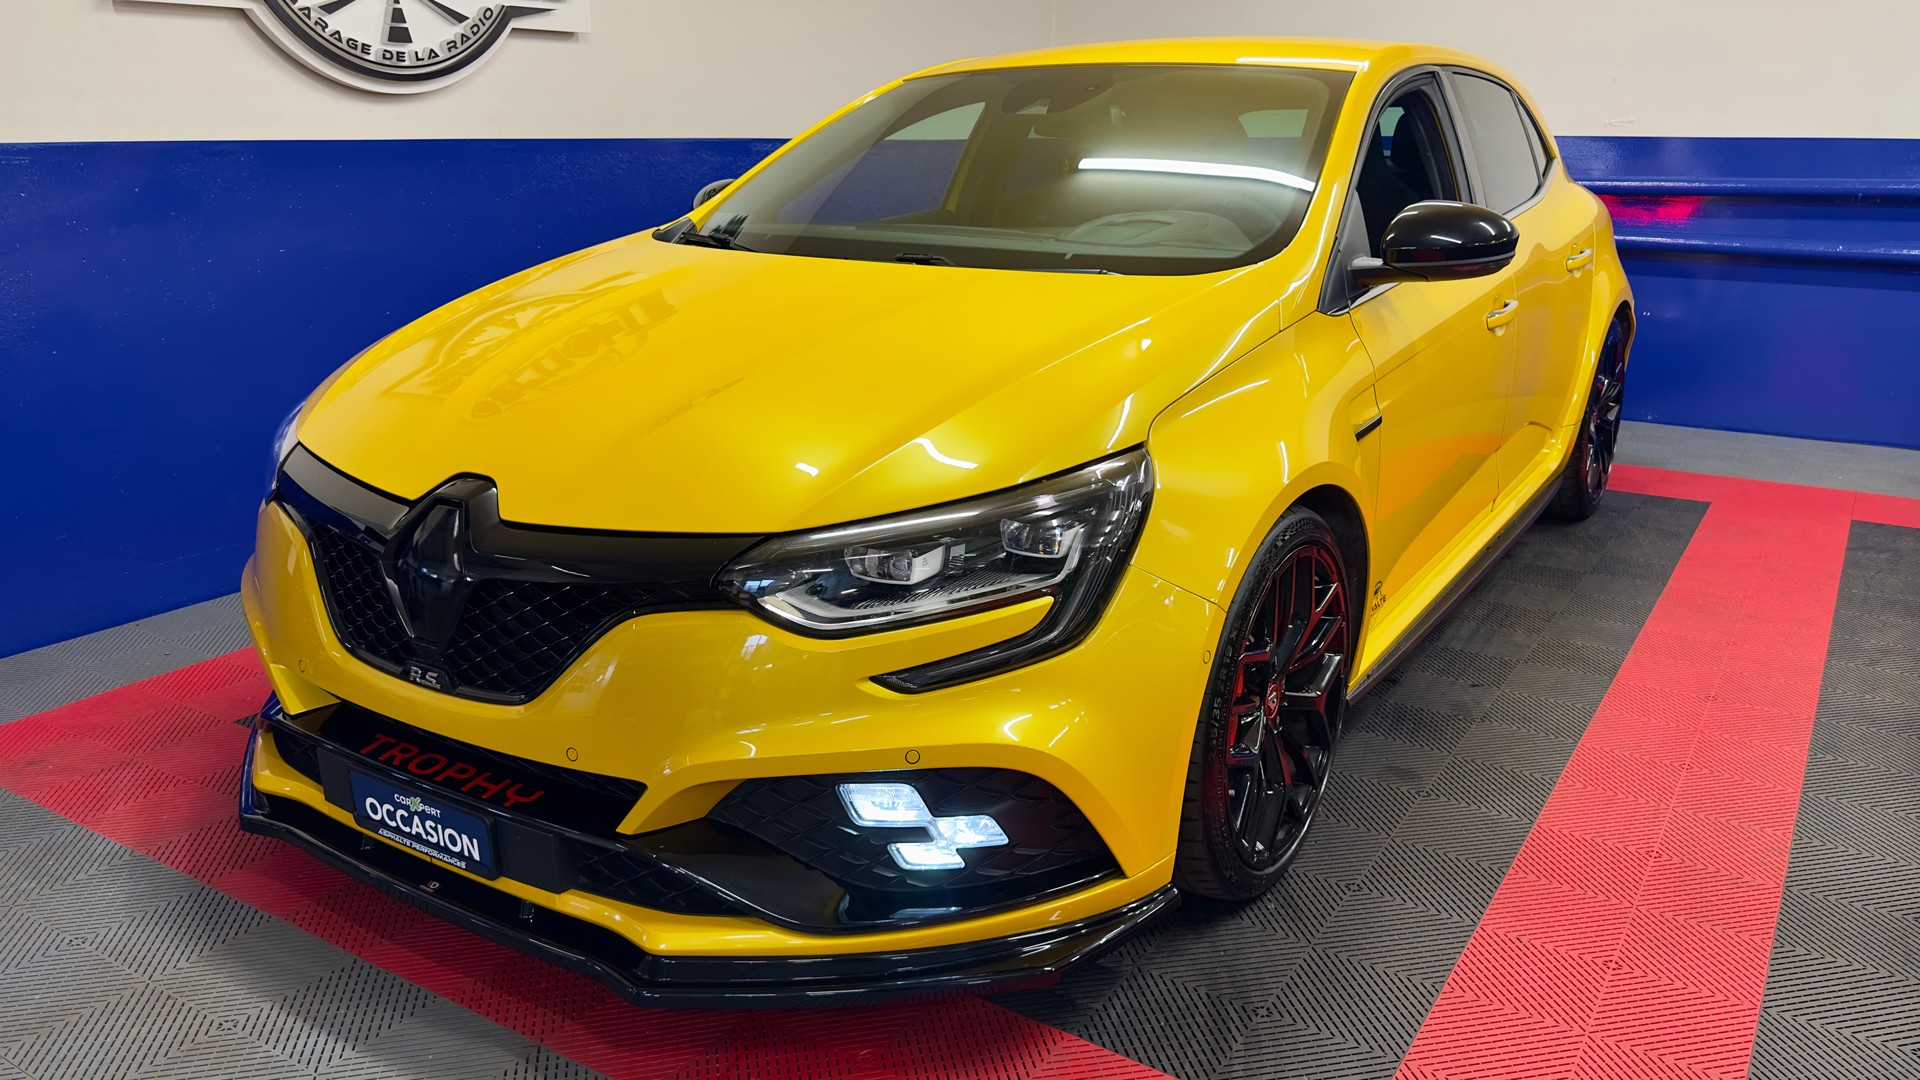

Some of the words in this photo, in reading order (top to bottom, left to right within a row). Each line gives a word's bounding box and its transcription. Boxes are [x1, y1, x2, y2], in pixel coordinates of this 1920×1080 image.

[382, 50, 406, 63] DE
[414, 48, 440, 62] LA
[446, 7, 494, 53] RADIO
[360, 733, 545, 808] TROPHY
[365, 797, 480, 862] OCCASION
